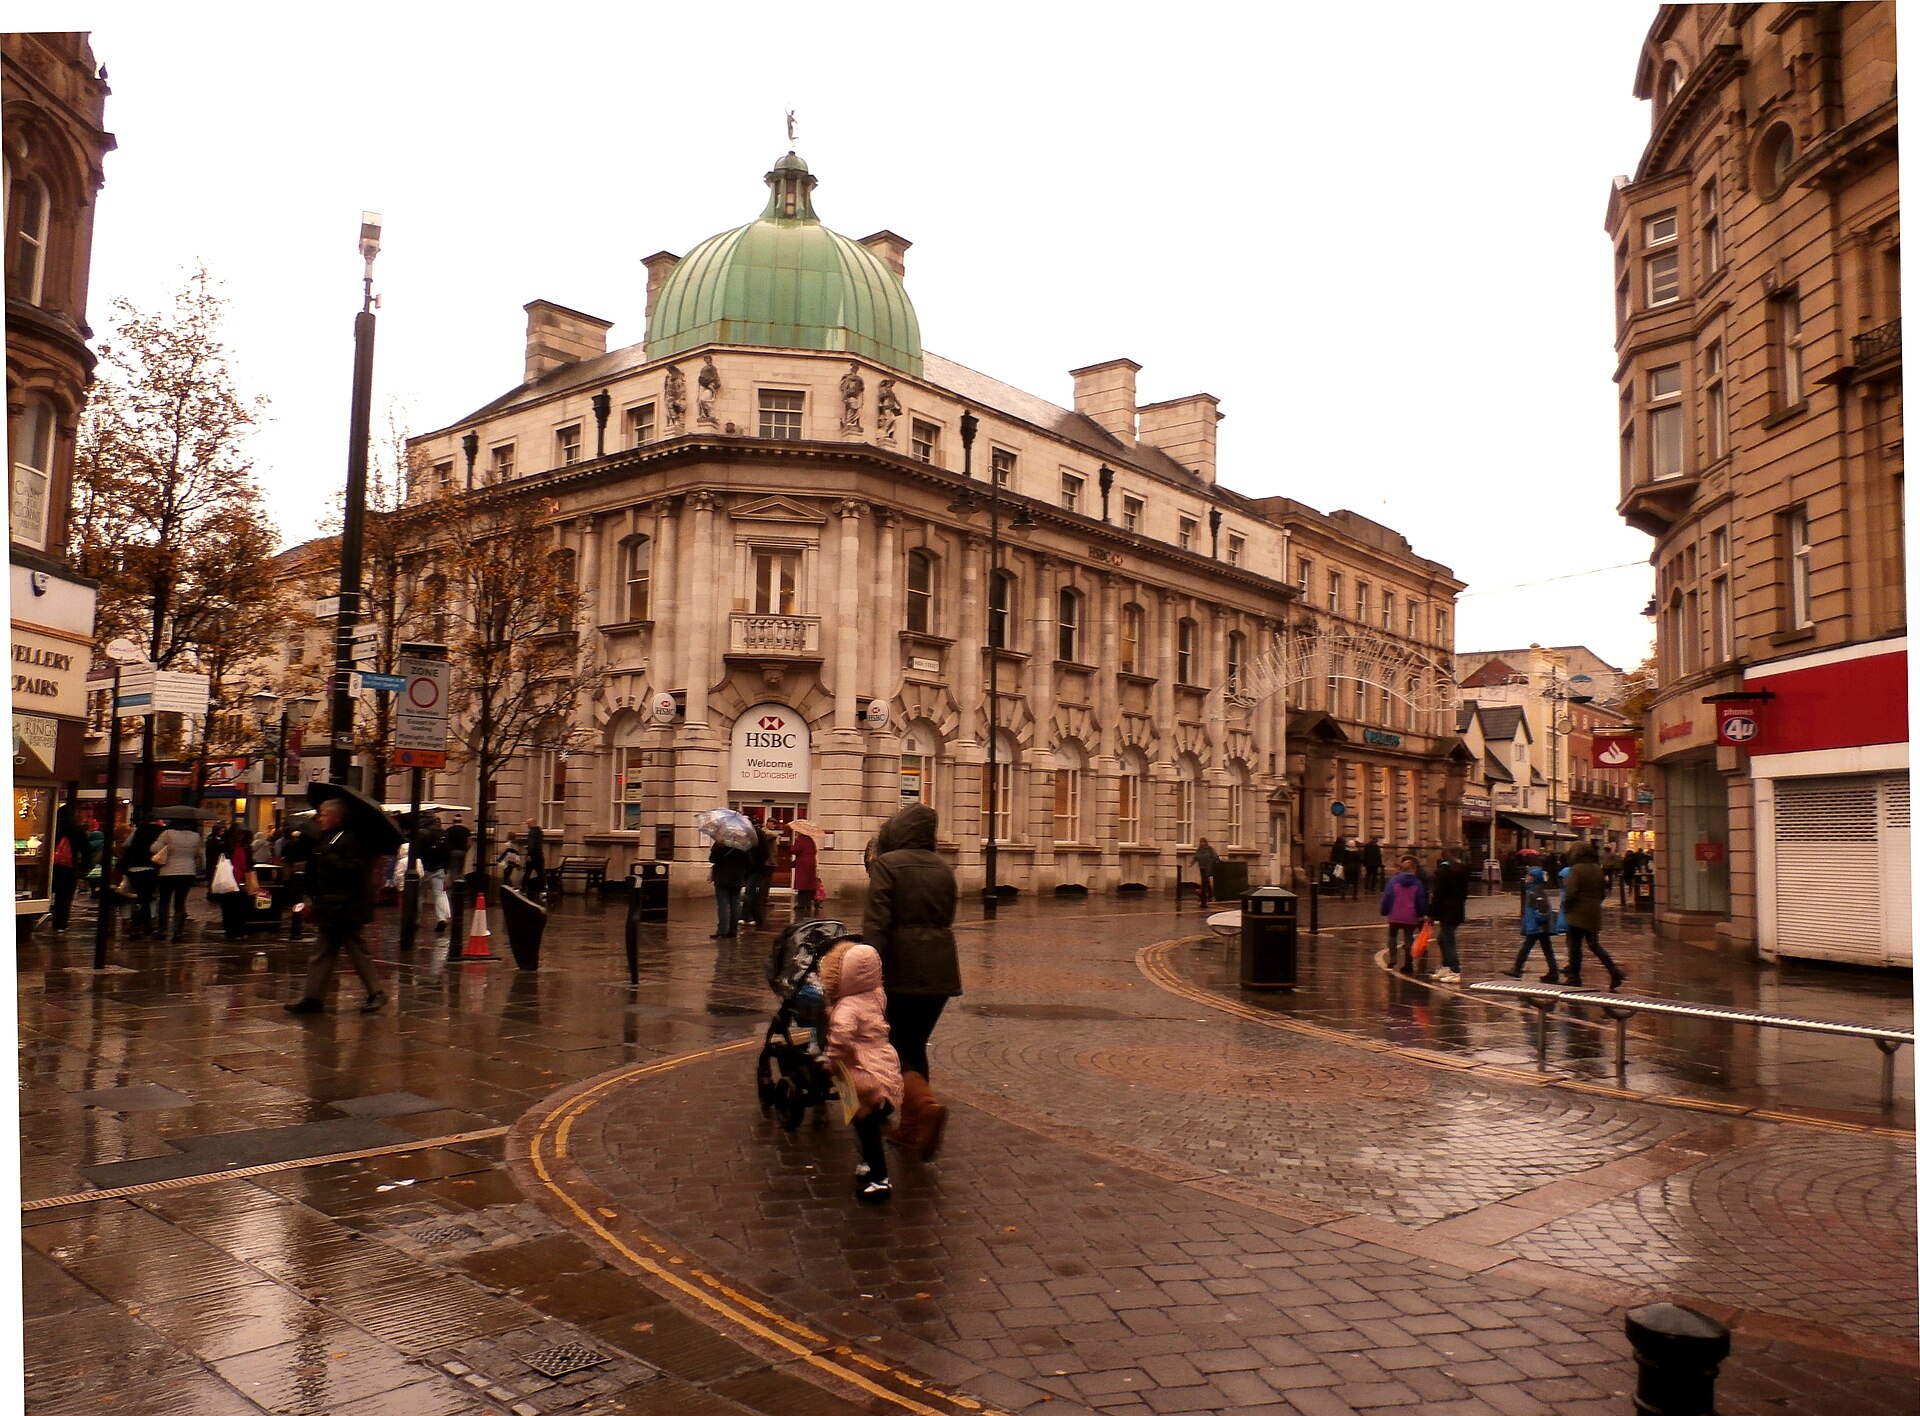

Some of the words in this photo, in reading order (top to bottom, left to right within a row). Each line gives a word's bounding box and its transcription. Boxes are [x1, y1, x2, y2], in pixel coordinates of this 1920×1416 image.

[410, 666, 439, 678] ZONE
[655, 706, 675, 716] HSBC
[1723, 708, 1754, 717] phones
[868, 713, 886, 722] HSBC
[744, 732, 797, 749] HSBC
[747, 758, 793, 769] Welcome
[741, 770, 751, 779] to
[753, 769, 798, 780] Doncaster
